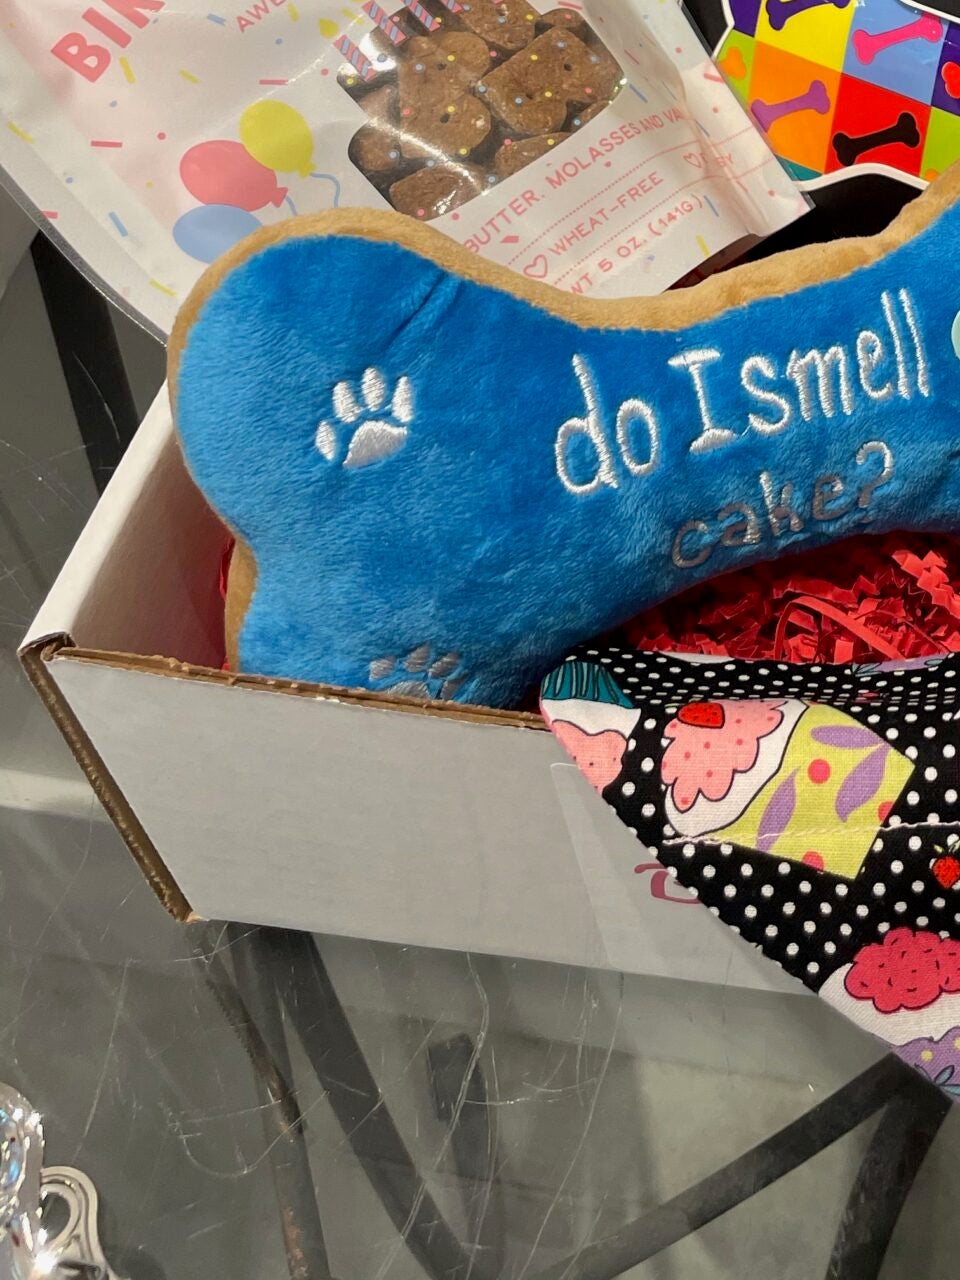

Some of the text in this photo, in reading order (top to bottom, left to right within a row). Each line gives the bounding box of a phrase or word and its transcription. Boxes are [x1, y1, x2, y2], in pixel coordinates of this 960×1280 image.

[545, 122, 642, 190] MOLASSES
[641, 114, 665, 133] AND
[549, 170, 665, 257] WHEAT-FREE
[598, 257, 613, 273] 5
[616, 236, 647, 259] OZ.
[648, 193, 704, 237] (141G)
[554, 352, 661, 495] do
[671, 439, 896, 569] cake?
